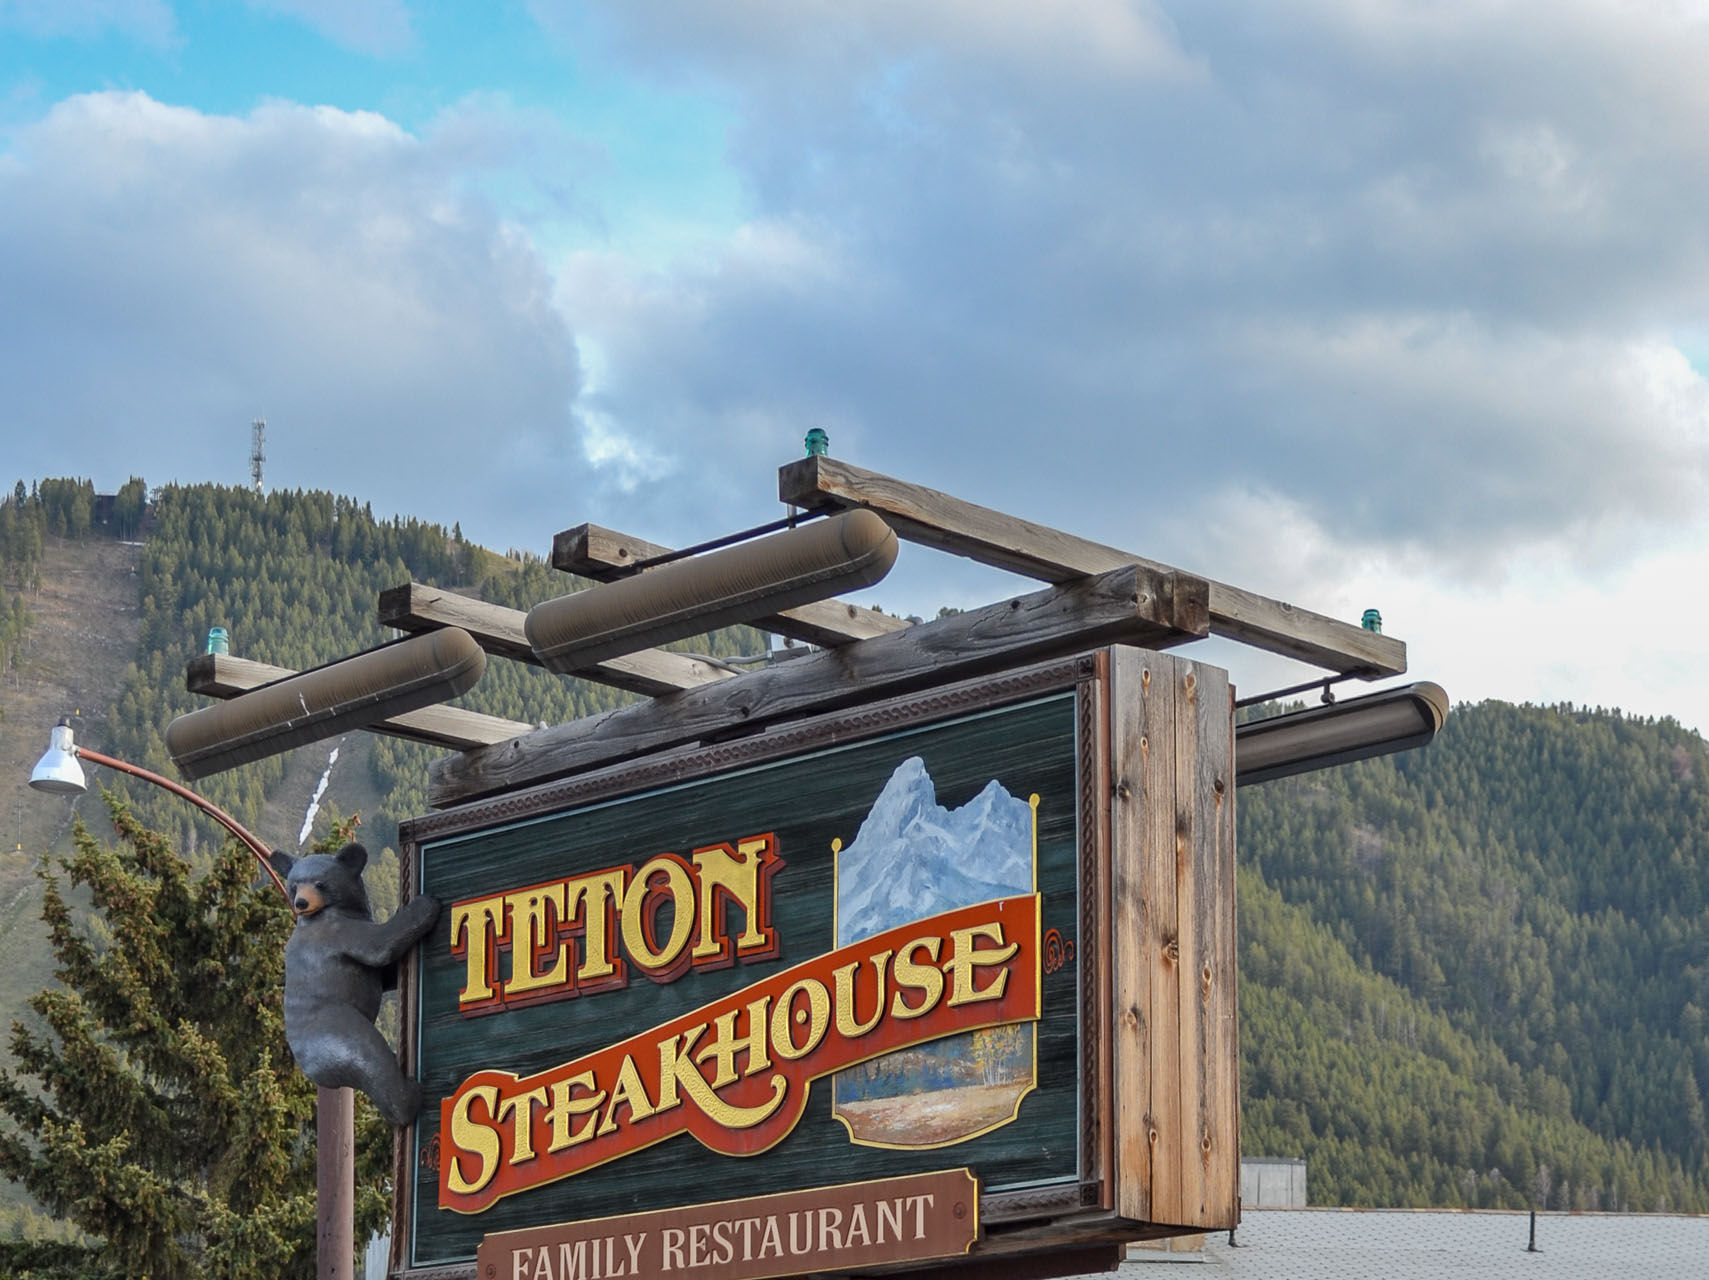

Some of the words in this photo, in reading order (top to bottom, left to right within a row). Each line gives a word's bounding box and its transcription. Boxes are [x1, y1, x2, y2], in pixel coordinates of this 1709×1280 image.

[450, 836, 772, 1006] TETON
[446, 921, 1019, 1195] STEAKHOUSE
[661, 1194, 934, 1272] RESTAURANT
